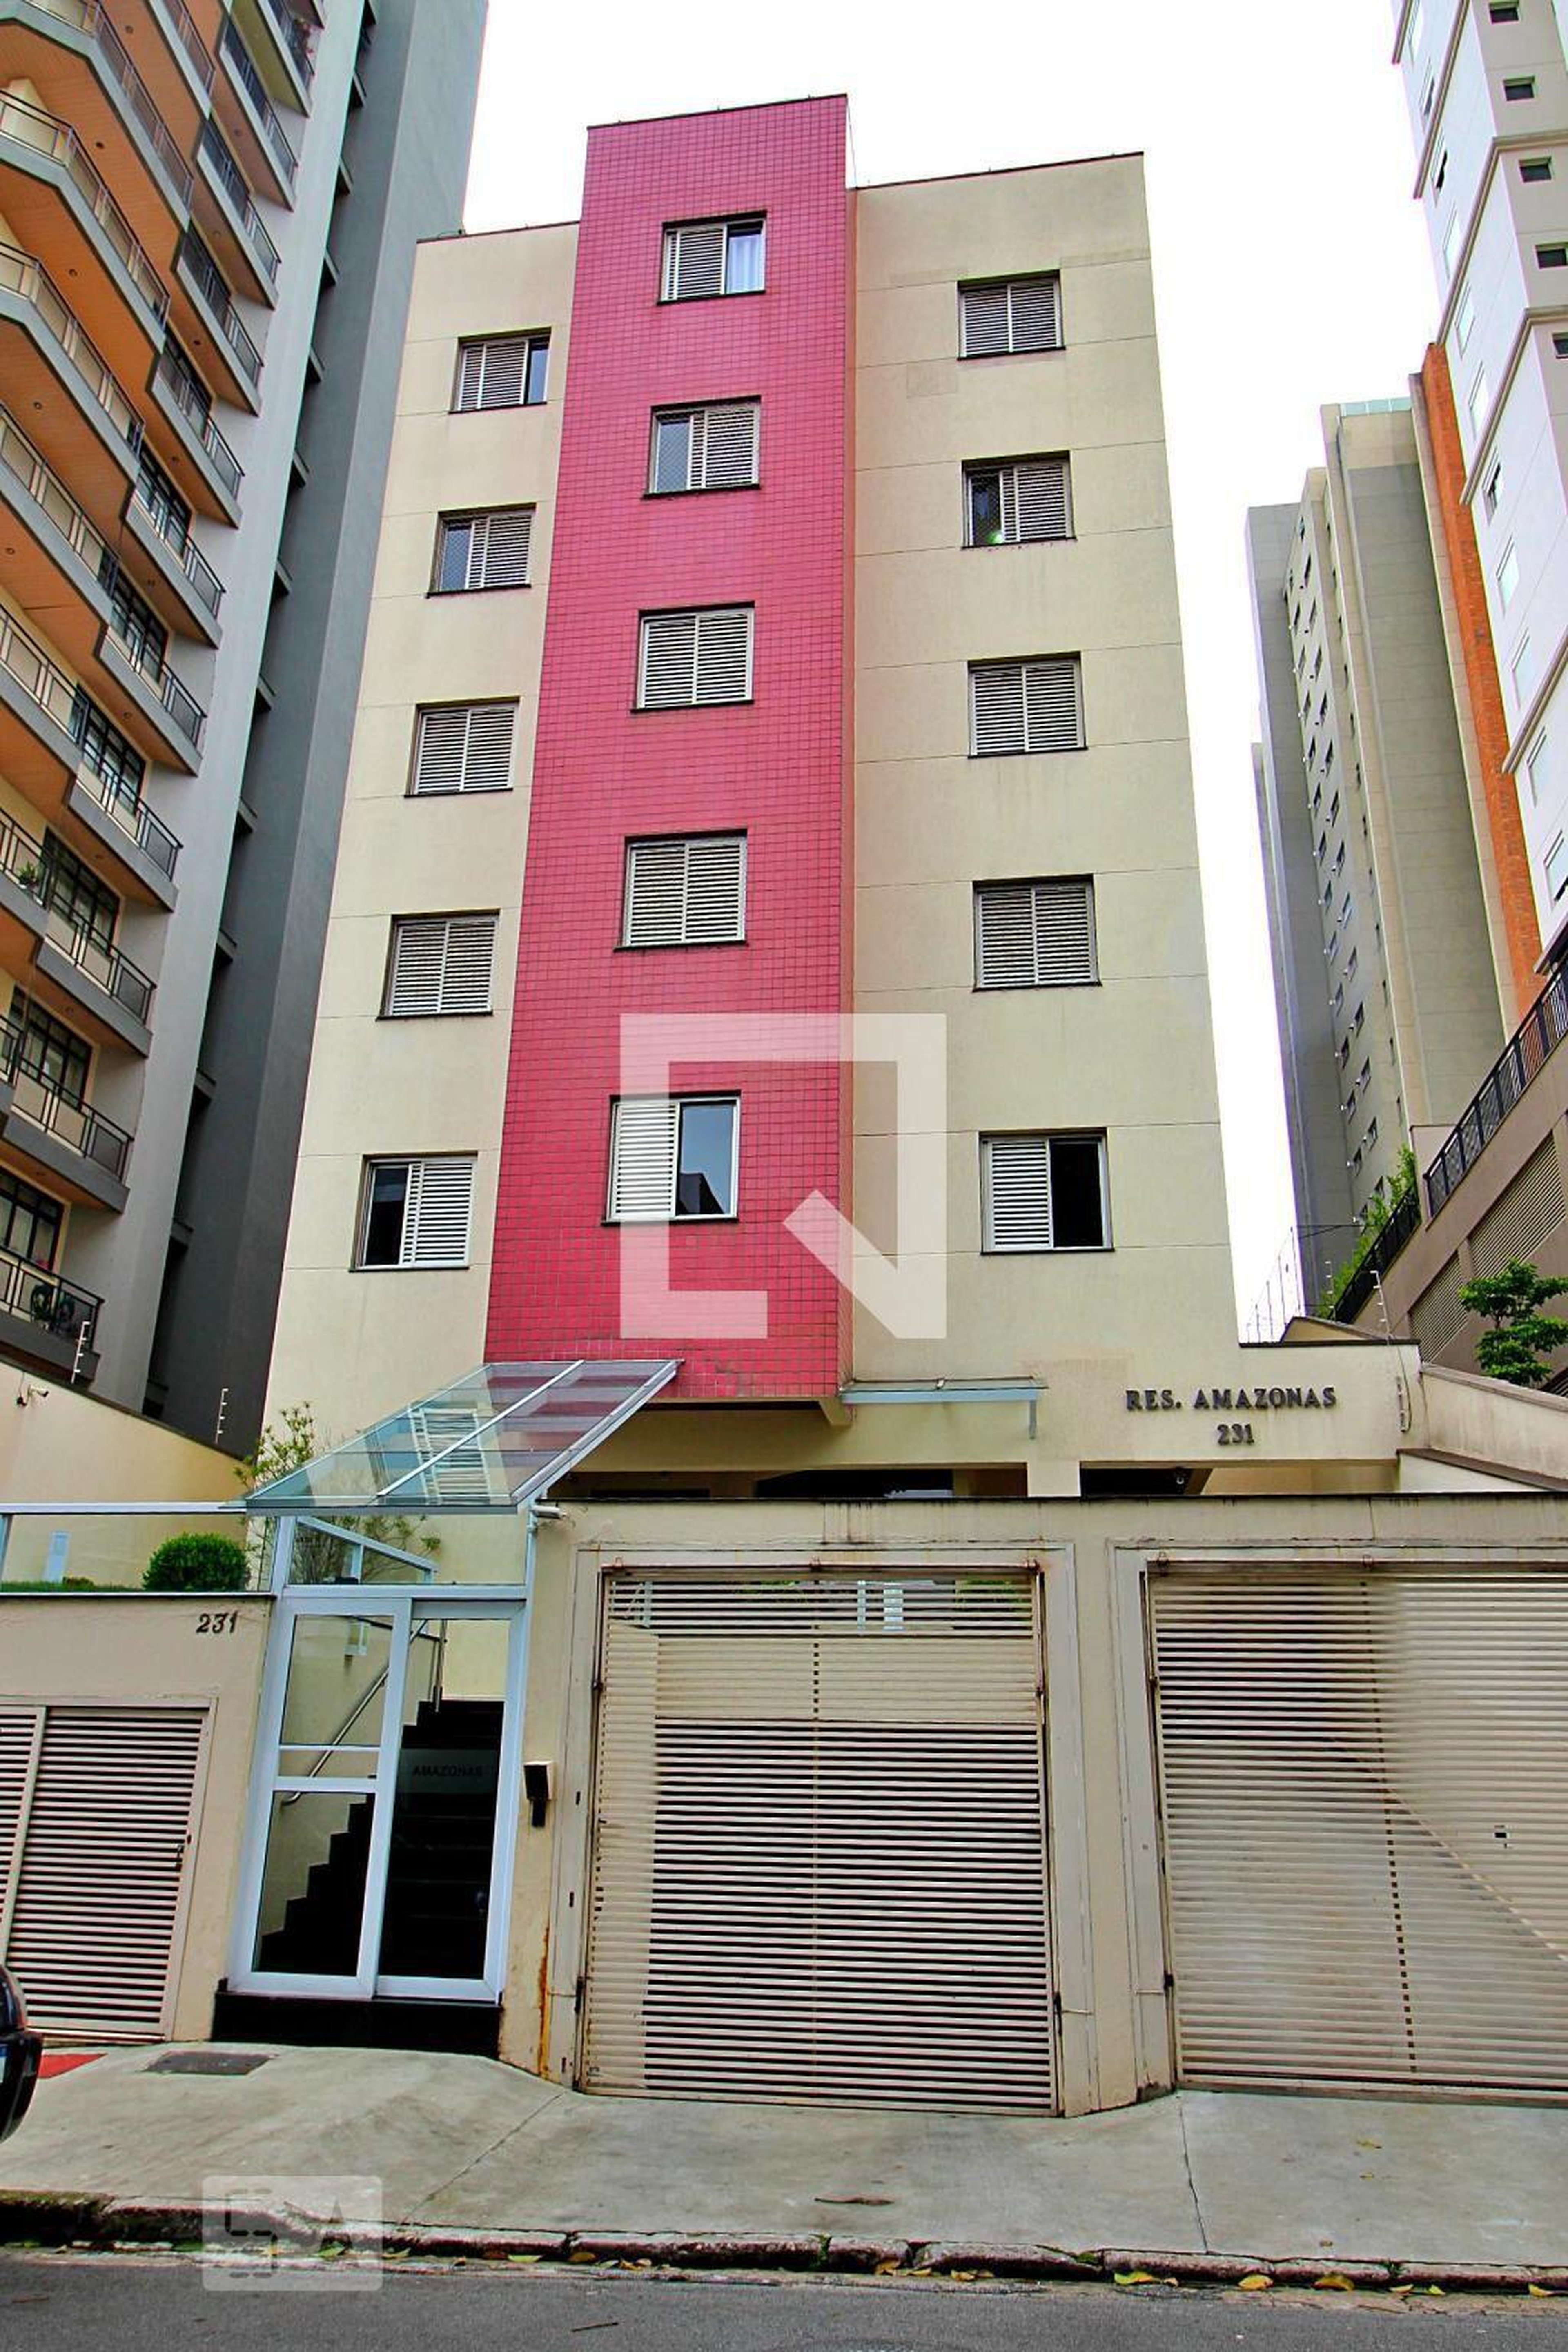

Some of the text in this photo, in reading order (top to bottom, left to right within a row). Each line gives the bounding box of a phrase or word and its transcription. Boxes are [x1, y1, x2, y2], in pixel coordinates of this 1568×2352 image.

[1126, 1387, 1337, 1410] RES. AMAZONAS
[1217, 1423, 1255, 1445] 231
[196, 1610, 238, 1634] 231
[413, 1764, 483, 1777] AMAZONAS
